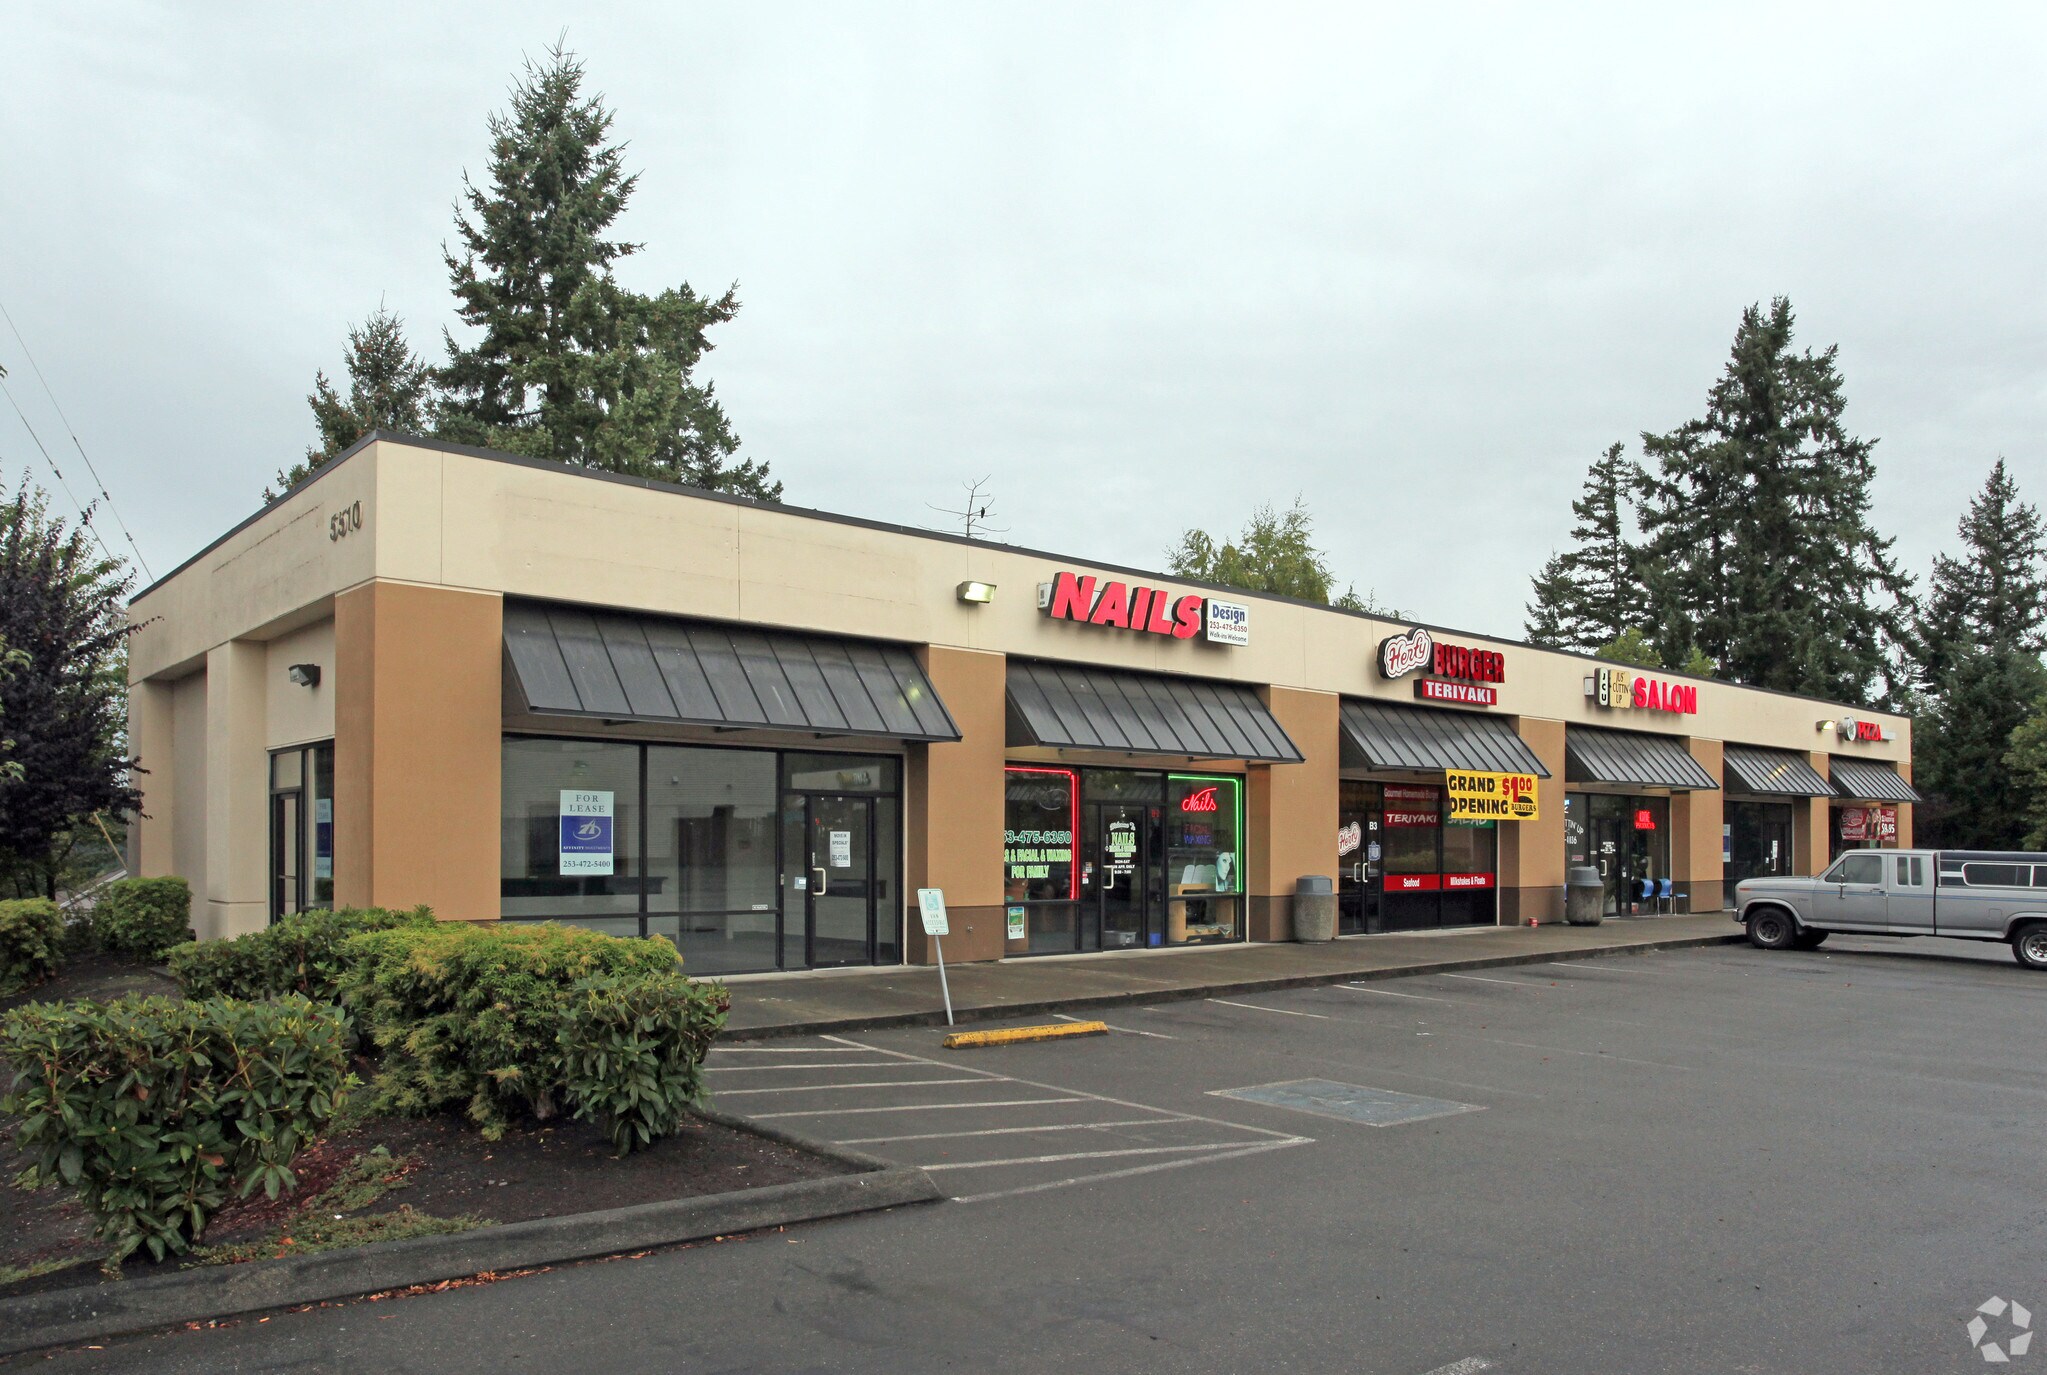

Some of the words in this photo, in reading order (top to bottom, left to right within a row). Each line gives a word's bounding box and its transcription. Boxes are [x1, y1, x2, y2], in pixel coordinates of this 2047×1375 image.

[330, 500, 362, 542] 5510
[1051, 572, 1204, 640] NAILS
[1212, 604, 1245, 624] Design
[1209, 621, 1248, 632] 253-475-6350
[1432, 642, 1504, 683] BURGER
[1426, 681, 1491, 703] TERIYAKI
[1634, 677, 1696, 714] SALON
[1857, 721, 1882, 741] PIZZA
[1448, 775, 1495, 793] GRAND
[576, 794, 599, 803] FOR
[1182, 787, 1218, 812] Nails
[569, 804, 605, 813] LEASE
[1450, 797, 1508, 815] OPENING
[1511, 803, 1536, 812] BURGERS
[1386, 813, 1437, 824] TERIYAKI
[1369, 821, 1378, 831] B3
[1111, 832, 1135, 846] NAILS
[1046, 849, 1072, 862] WAXING
[563, 860, 611, 868] 253-472-5400
[1011, 865, 1026, 878] FOR
[1026, 865, 1049, 878] FAMILY
[1403, 878, 1420, 888] Seafood
